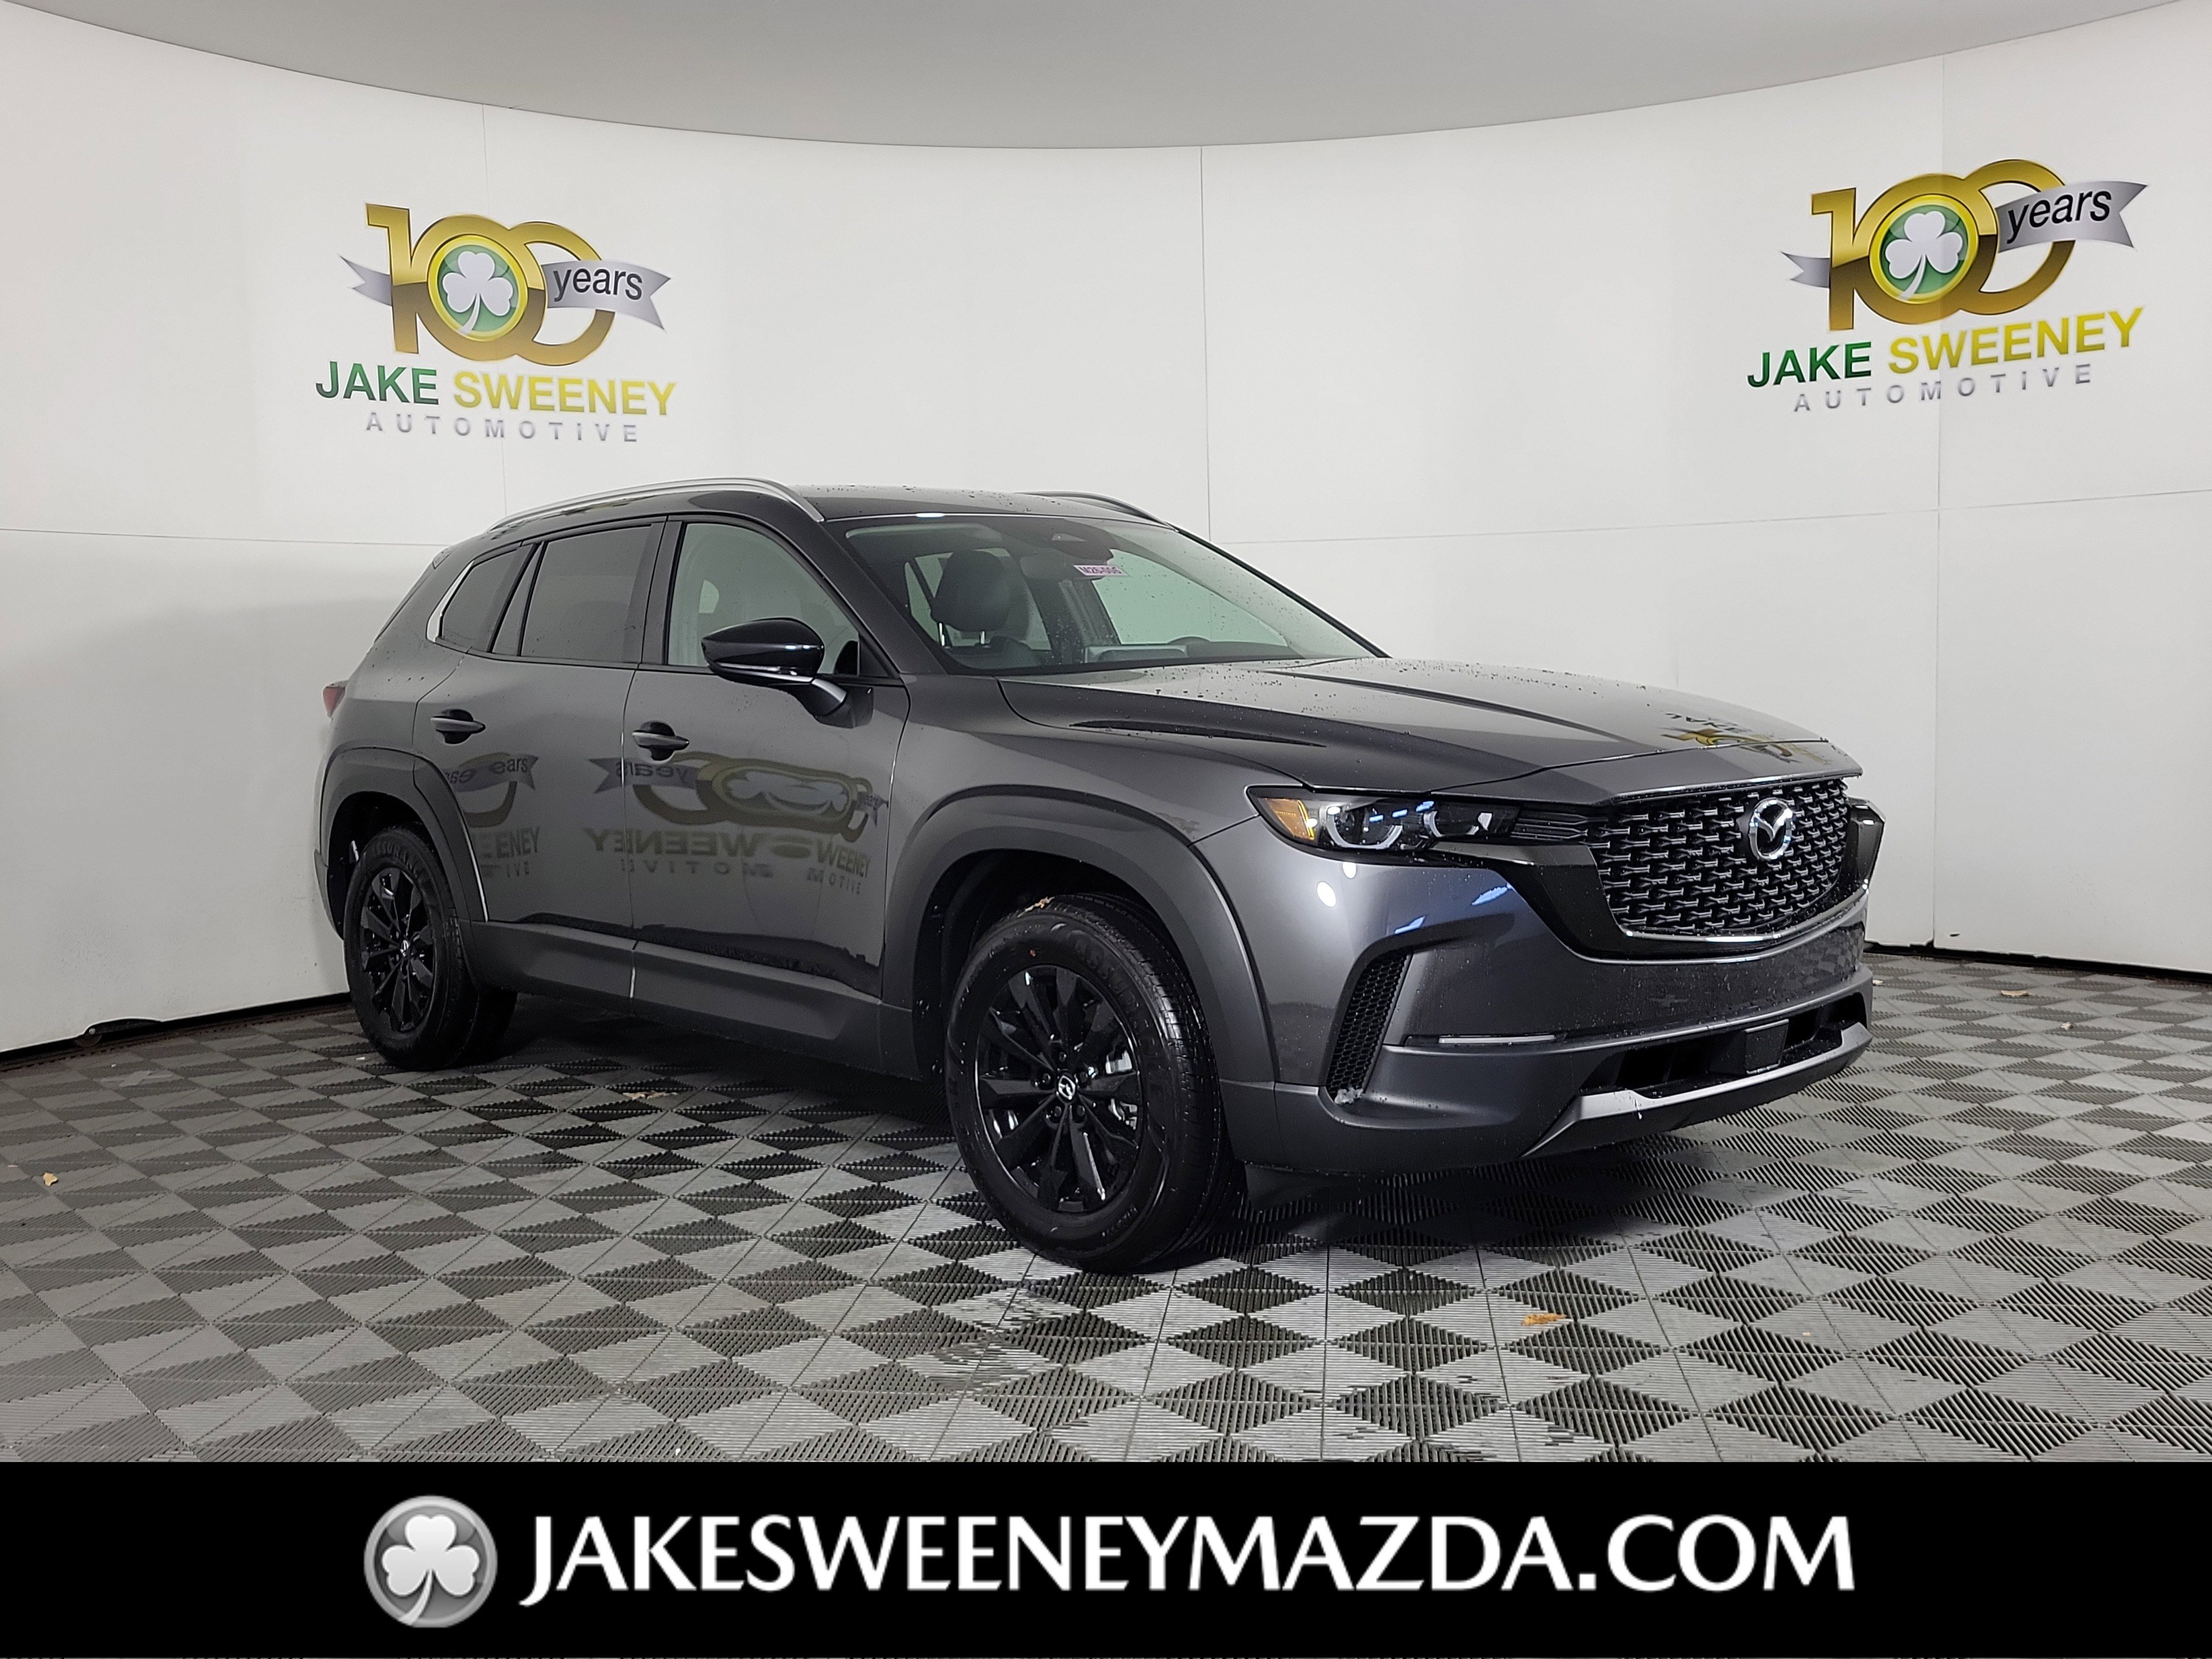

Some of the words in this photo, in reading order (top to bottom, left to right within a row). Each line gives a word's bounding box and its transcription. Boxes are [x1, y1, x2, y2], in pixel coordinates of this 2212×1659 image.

[2007, 190, 2112, 244] years
[1810, 158, 2076, 331] 100
[365, 202, 616, 366] 100
[553, 267, 643, 302] years
[1747, 341, 1872, 388] JAKE
[1888, 307, 2143, 374] SWEENEY
[315, 360, 439, 405] JAKE
[453, 371, 676, 415] SWEENEY
[1793, 364, 2091, 413] AUTOMOTIVE
[365, 412, 637, 442] AUTOMOTIVE
